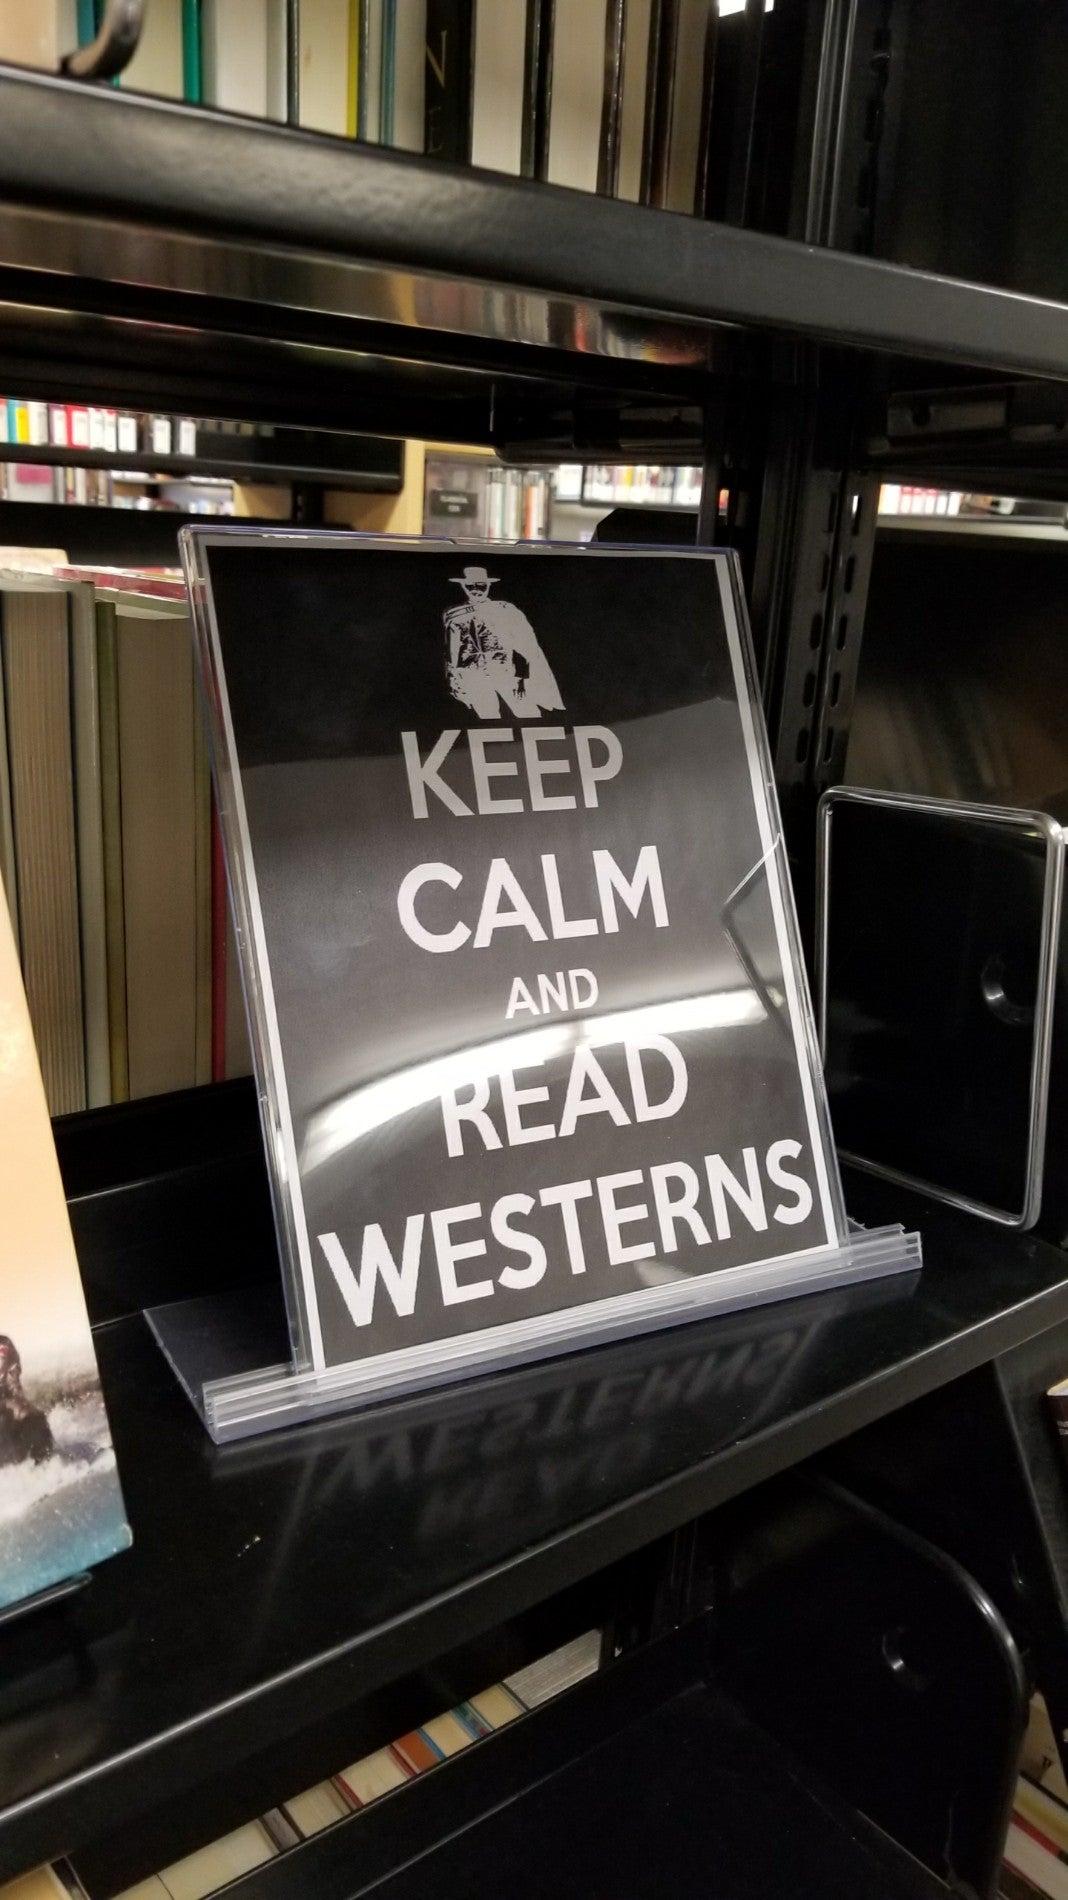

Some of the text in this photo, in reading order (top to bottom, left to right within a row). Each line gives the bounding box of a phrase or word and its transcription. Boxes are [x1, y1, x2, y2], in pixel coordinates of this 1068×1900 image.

[401, 724, 624, 820] KEEP
[397, 845, 670, 954] CALM
[505, 967, 600, 1019] AND
[440, 1032, 689, 1158] READ
[317, 1139, 813, 1327] WESTERNS
